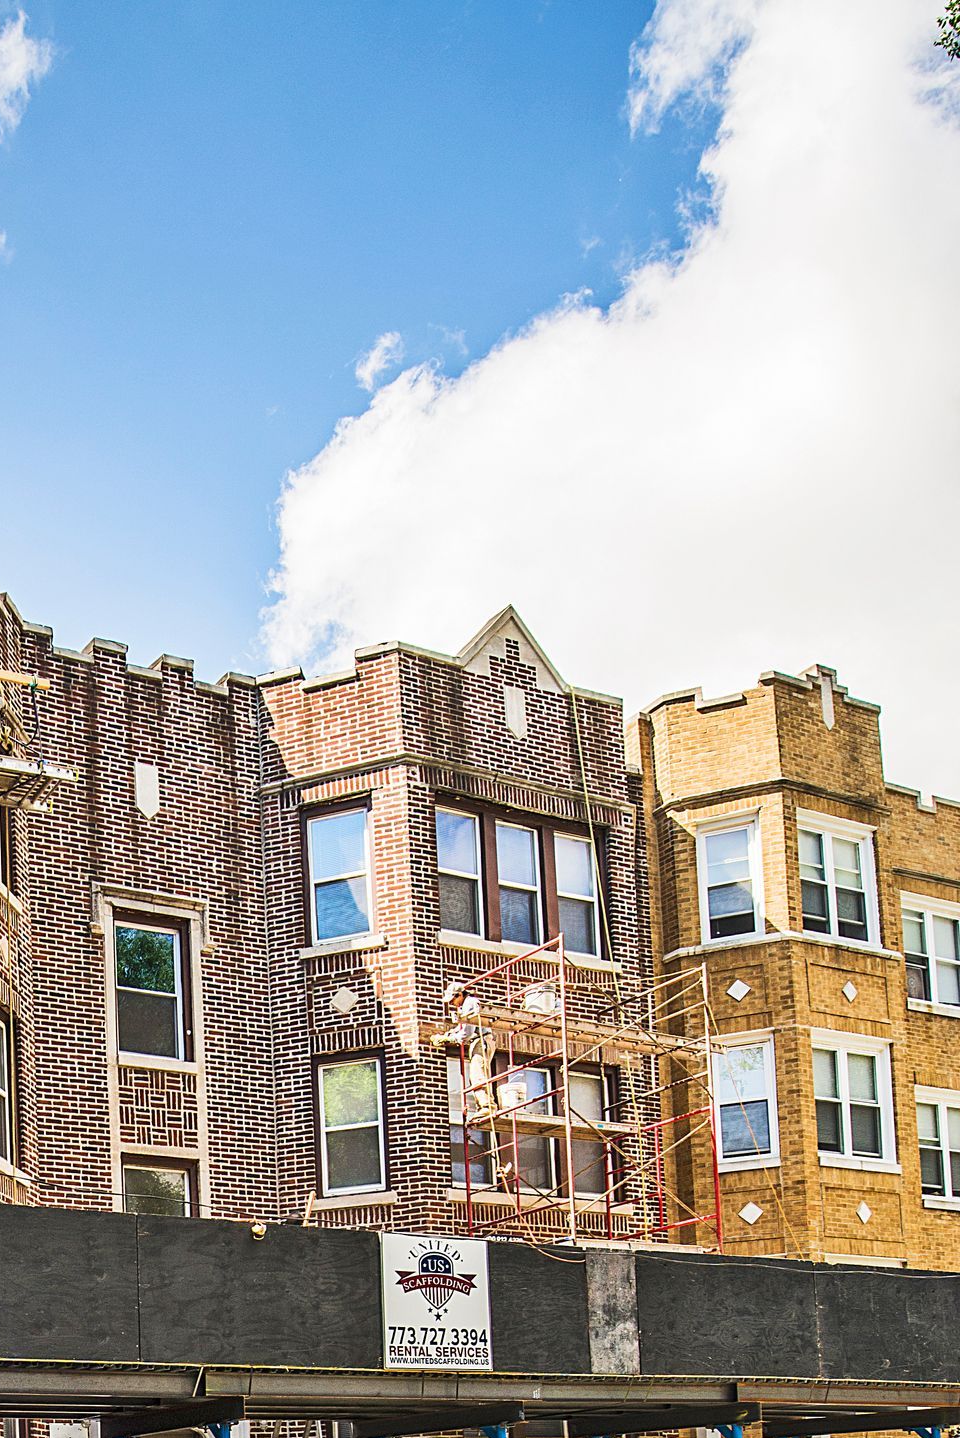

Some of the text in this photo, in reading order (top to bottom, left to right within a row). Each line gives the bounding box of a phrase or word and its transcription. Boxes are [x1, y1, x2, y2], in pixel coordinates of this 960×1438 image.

[409, 1240, 461, 1261] UNITED
[427, 1259, 445, 1273] US
[403, 1277, 470, 1293] SCAFFOLDING
[388, 1326, 488, 1347] 773.727.3394
[389, 1346, 489, 1358] RENTAL SERVICES
